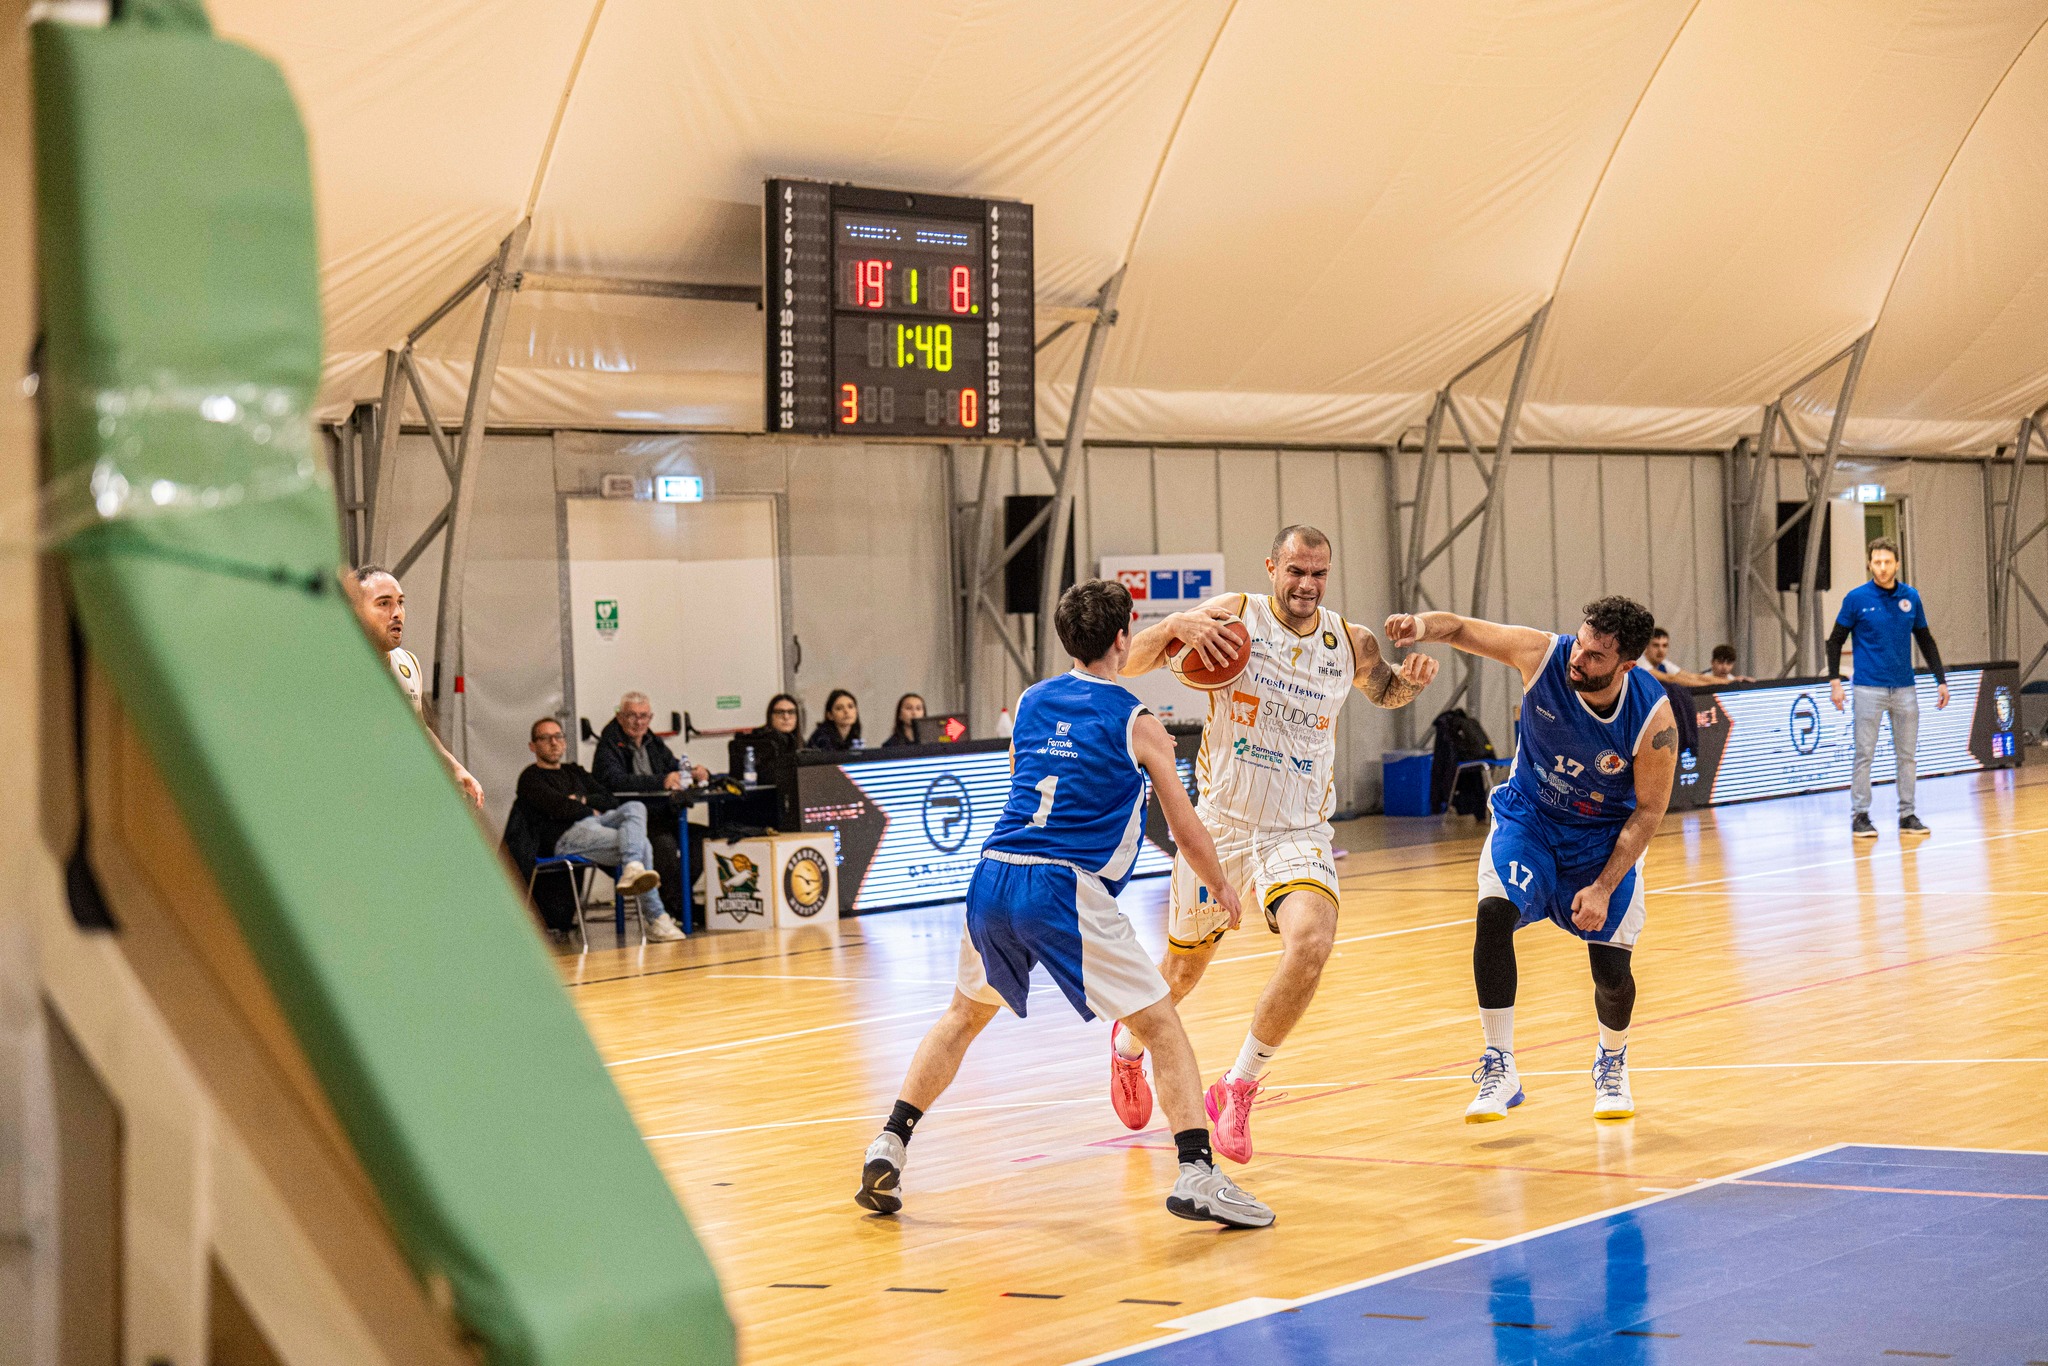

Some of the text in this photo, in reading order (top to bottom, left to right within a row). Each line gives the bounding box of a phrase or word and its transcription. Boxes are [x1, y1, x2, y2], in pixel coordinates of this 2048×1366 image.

[784, 187, 792, 203] 4
[785, 207, 792, 224] 5
[991, 206, 999, 222] 4
[785, 228, 792, 244] 6
[992, 225, 999, 241] 5
[785, 248, 792, 264] 7
[991, 245, 999, 260] 6
[785, 268, 792, 285] 8
[991, 263, 999, 279] 7
[856, 259, 884, 308] 19
[910, 269, 918, 304] 1
[952, 265, 970, 314] 8
[992, 282, 999, 298] 8
[785, 289, 793, 305] 9
[992, 301, 999, 317] 9
[780, 309, 794, 326] 10
[780, 329, 793, 346] 11
[897, 324, 952, 372] 1:48
[987, 341, 999, 357] 11
[780, 350, 793, 367] 12
[987, 360, 1000, 376] 12
[780, 370, 793, 388] 13
[988, 379, 1000, 395] 13
[780, 391, 794, 408] 14
[841, 383, 858, 424] 3
[988, 399, 1000, 414] 14
[960, 388, 978, 428] 0
[780, 411, 794, 428] 15
[988, 417, 1000, 433] 15
[1290, 648, 1302, 667] 7
[1318, 666, 1342, 677] THE KING
[1254, 673, 1285, 690] Fresh
[1269, 719, 1283, 727] TUO
[1047, 737, 1073, 748] Ferrovie
[1049, 749, 1078, 759] Gargano
[1251, 751, 1283, 764] Sant'Elia
[1252, 745, 1283, 758] Farmacia
[1554, 754, 1585, 778] 17
[1025, 775, 1058, 828] 1
[1311, 848, 1322, 858] 7
[1508, 861, 1533, 892] 17
